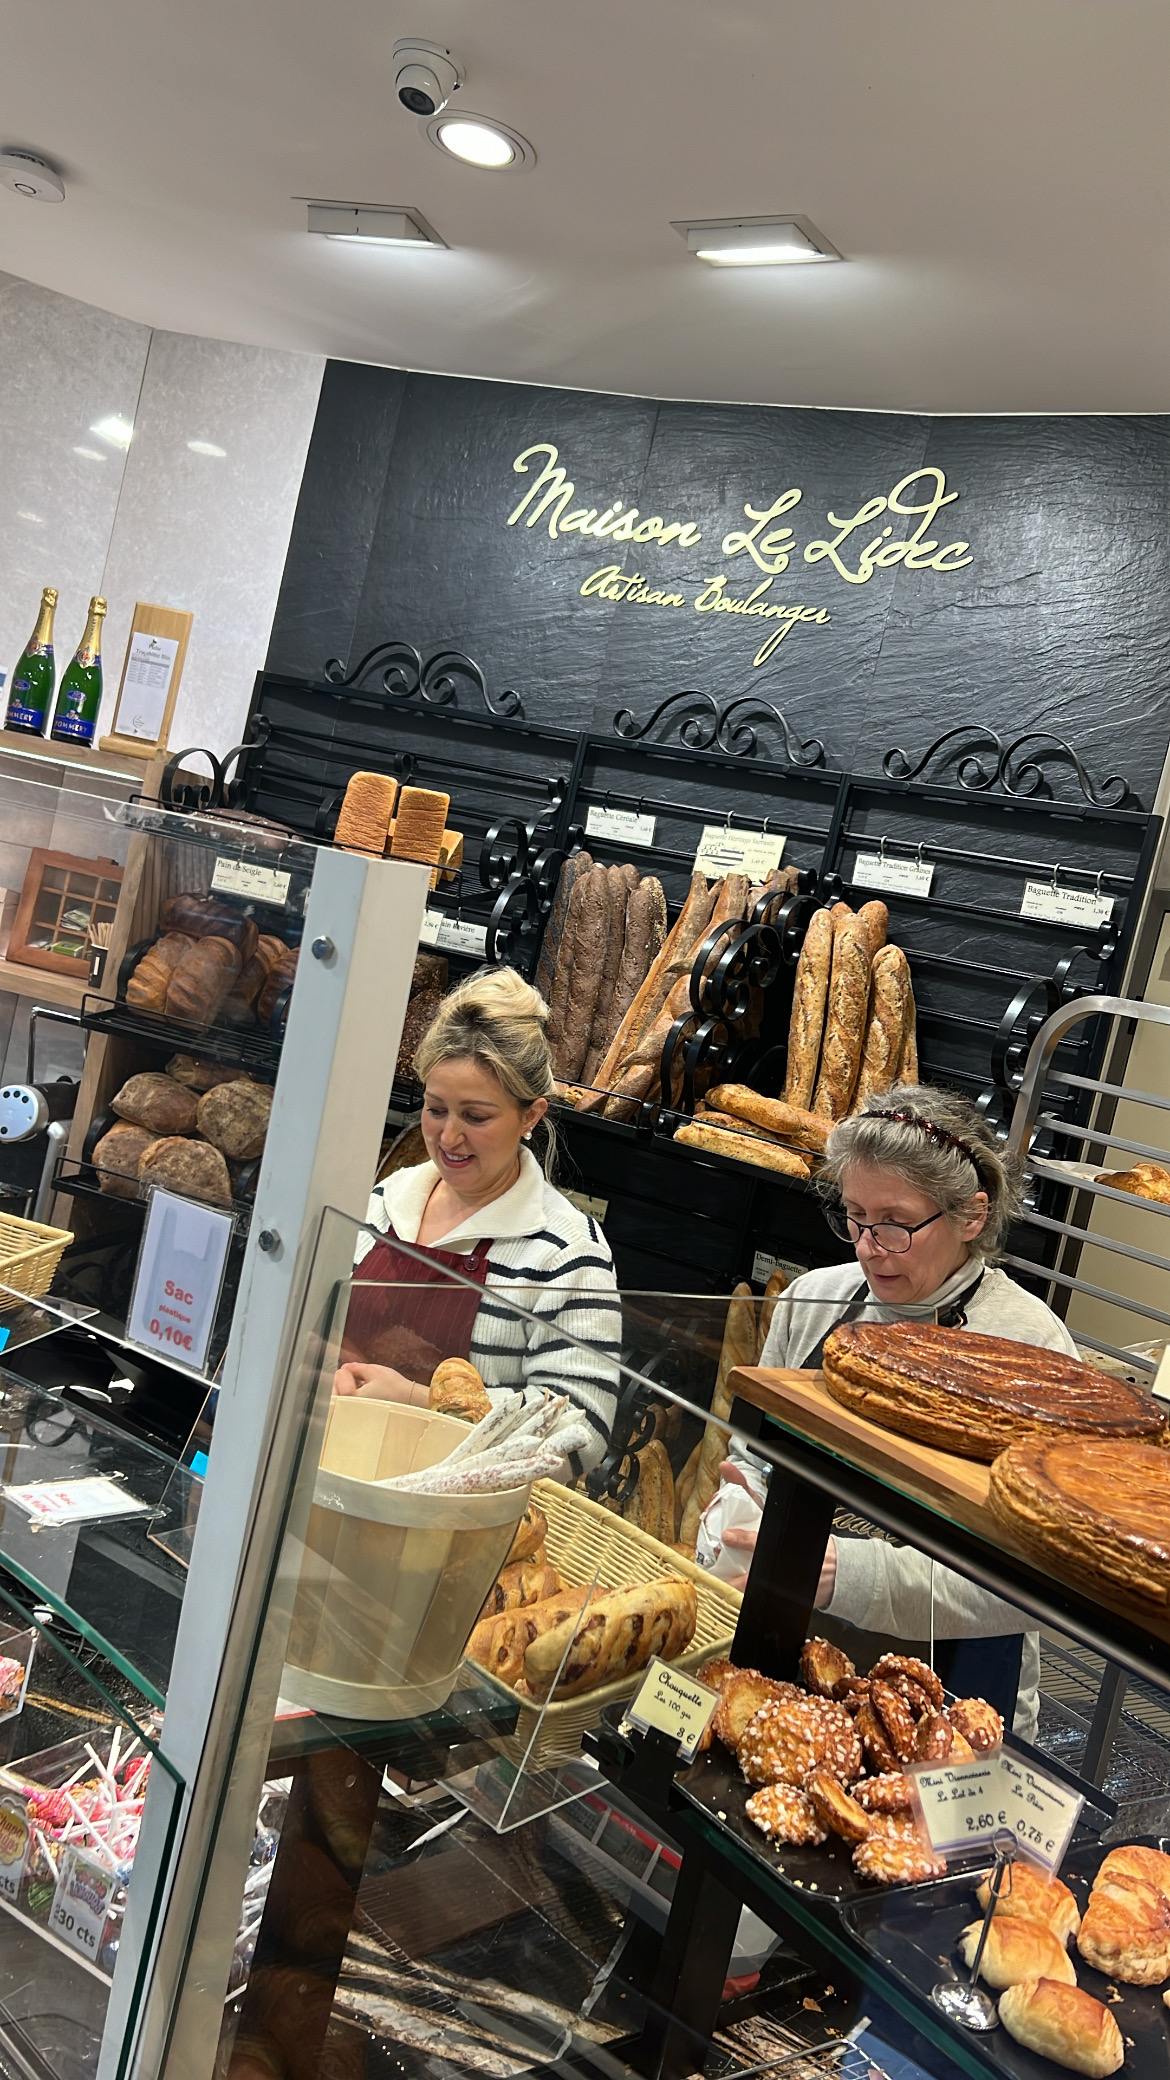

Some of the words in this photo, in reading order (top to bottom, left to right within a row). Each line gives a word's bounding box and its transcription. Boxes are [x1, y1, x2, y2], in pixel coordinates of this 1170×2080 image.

[507, 443, 701, 548] Maison
[721, 488, 803, 575] Le
[804, 467, 974, 584] Lidec
[580, 565, 686, 607] Artisan
[694, 574, 832, 667] Boulanger
[217, 860, 232, 869] Pain
[242, 865, 262, 876] Seigle
[883, 861, 908, 871] Tradition
[1027, 886, 1060, 898] Baguette
[1062, 891, 1097, 905] Tradition
[756, 1253, 802, 1274] Demi-baguette
[164, 1280, 194, 1305] Sac
[158, 1304, 192, 1324] plastique
[149, 1318, 194, 1351] 0,10€
[658, 1671, 702, 1707] Chouquette
[668, 1700, 681, 1712] 100
[687, 1733, 696, 1744] €
[920, 1776, 943, 1788] Mini
[944, 1771, 991, 1782] Viennoiserie
[1001, 1760, 1022, 1779] Mini
[937, 1790, 948, 1802] Le
[952, 1788, 966, 1800] Lot
[966, 1813, 994, 1831] 2,60
[998, 1810, 1007, 1824] €
[1016, 1819, 1043, 1844] 0,75
[1045, 1840, 1055, 1853] €
[58, 1907, 75, 1931] 30
[77, 1926, 96, 1948] cts
